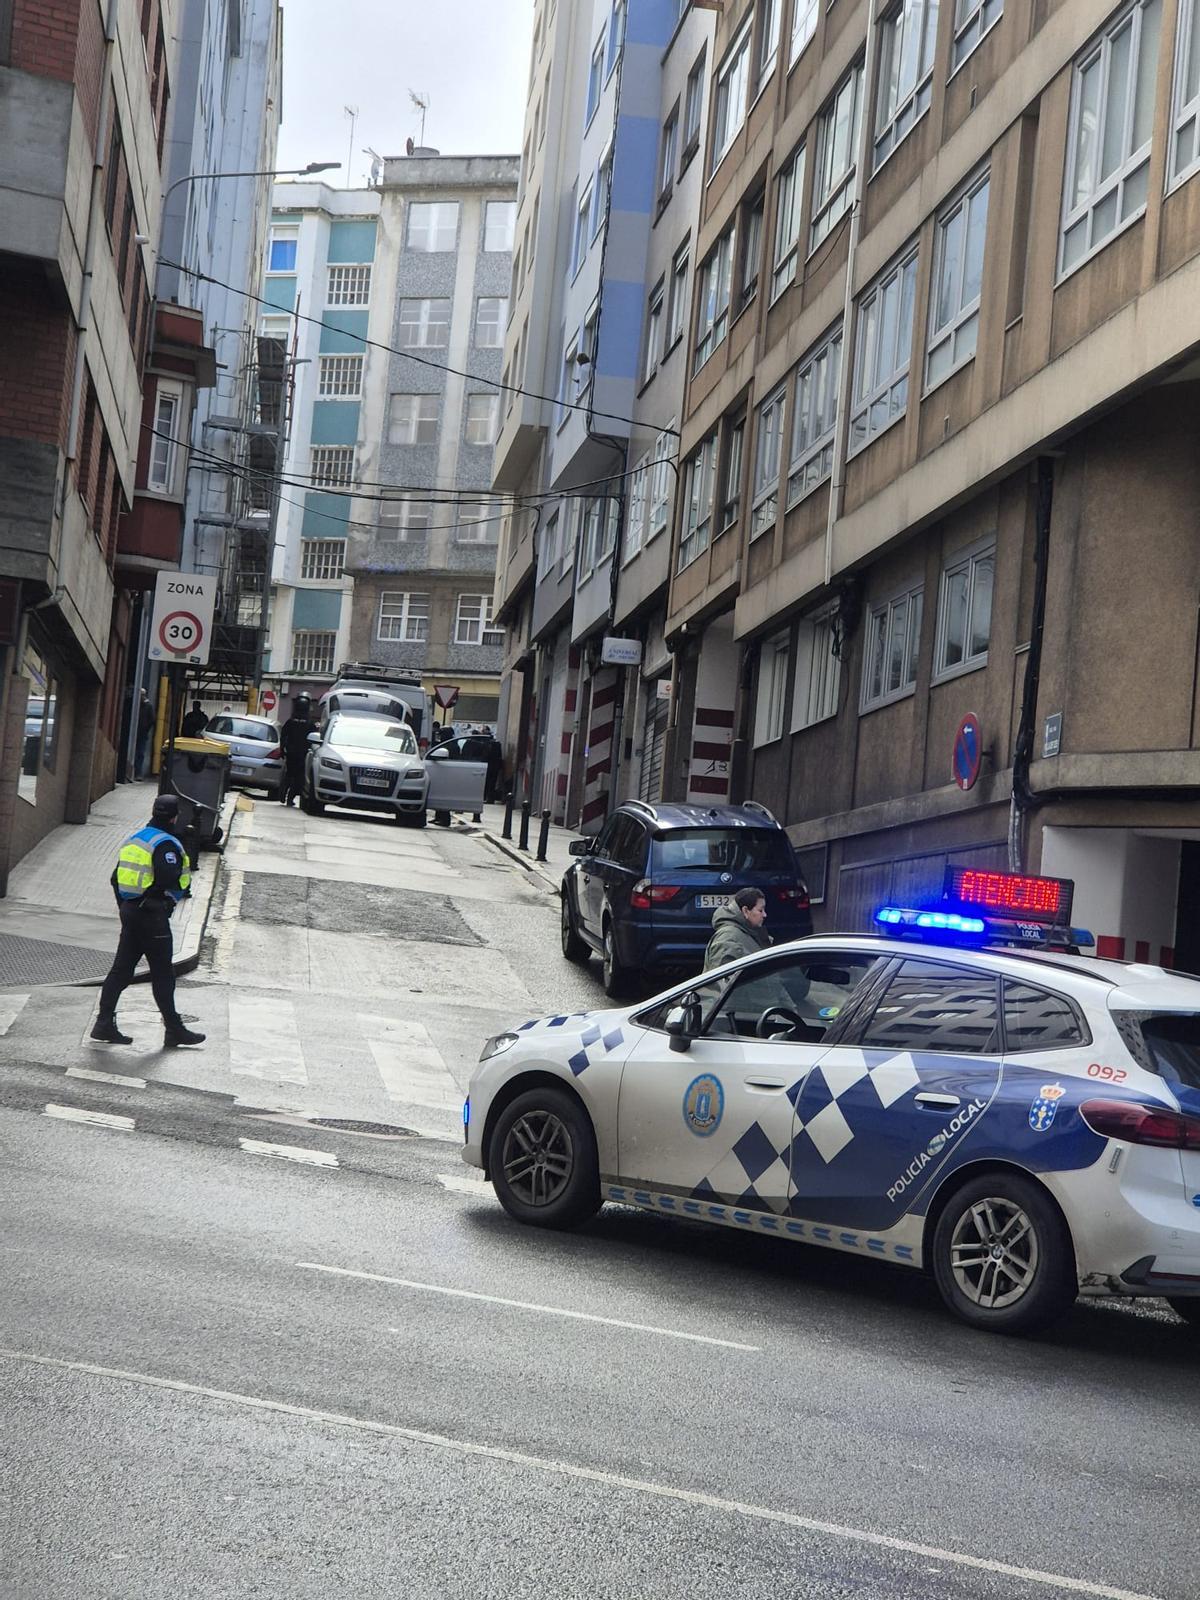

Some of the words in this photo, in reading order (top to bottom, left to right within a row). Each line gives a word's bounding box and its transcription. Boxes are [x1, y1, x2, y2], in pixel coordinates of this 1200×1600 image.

[167, 582, 204, 596] ZONA
[169, 624, 193, 640] 30
[702, 895, 730, 908] 5132
[1021, 929, 1041, 940] LOCAL
[1087, 1063, 1127, 1083] 092
[886, 1152, 932, 1203] POLICÍA
[942, 1098, 987, 1140] LOCAL
